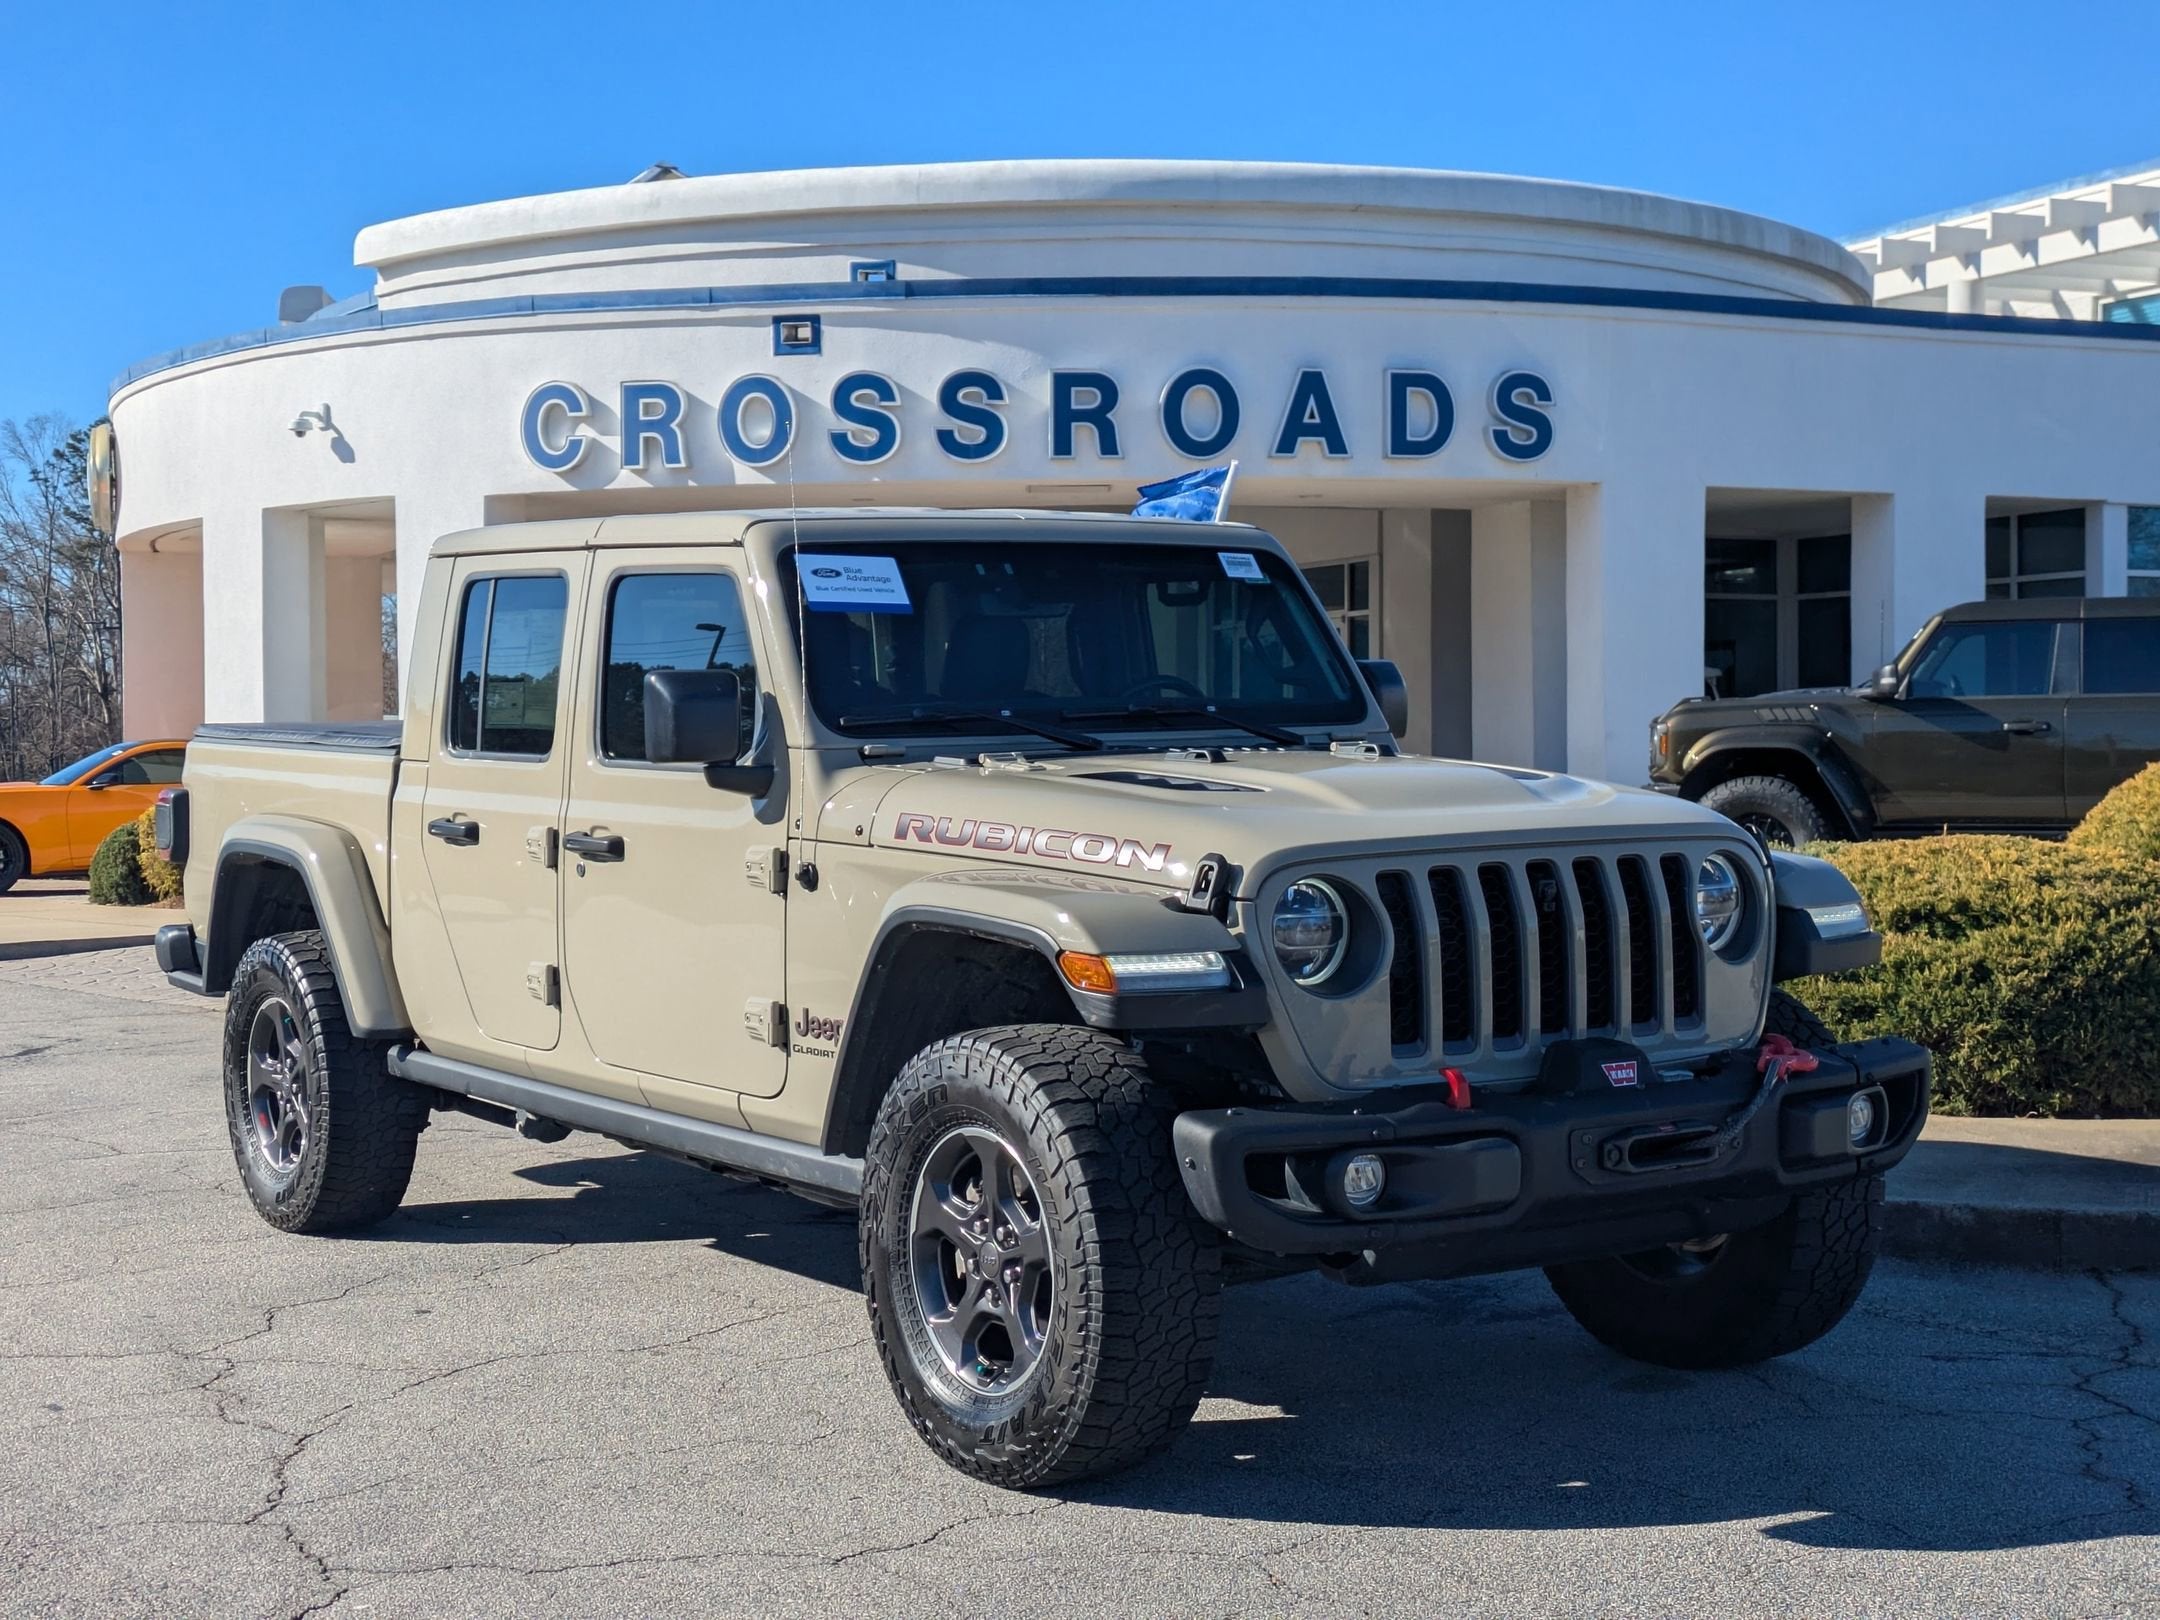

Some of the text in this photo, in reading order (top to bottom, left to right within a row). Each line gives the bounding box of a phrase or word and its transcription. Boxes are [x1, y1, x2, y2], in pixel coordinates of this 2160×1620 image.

[521, 366, 1556, 473] CROSSROADS
[843, 567, 863, 575] Blue
[846, 575, 892, 584] Advantage
[830, 585, 856, 593] Certified
[893, 812, 1173, 872] RUBICON
[792, 1044, 836, 1059] GLADIAT
